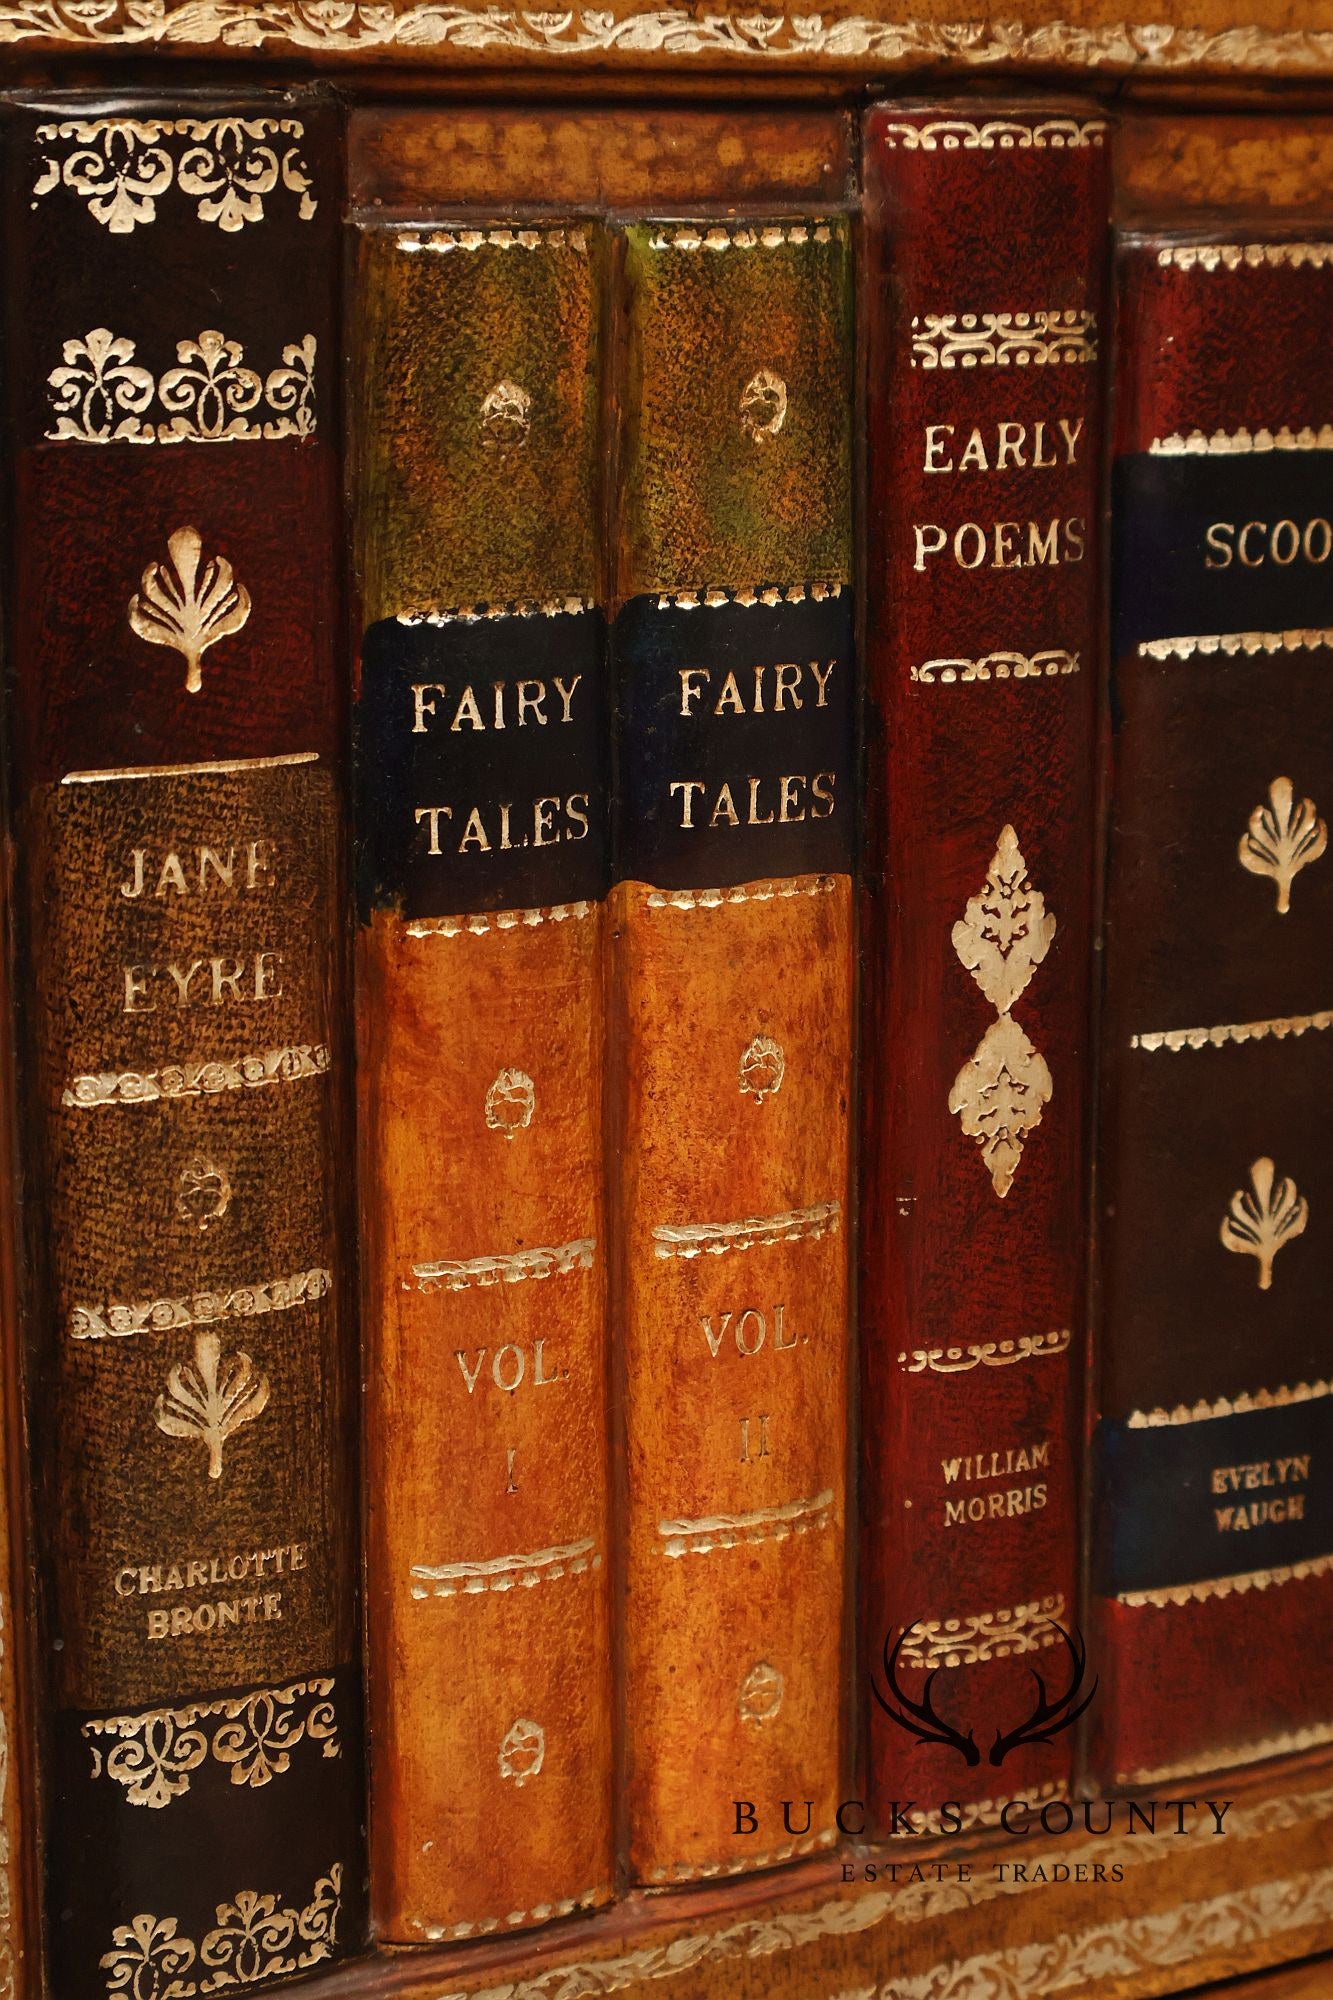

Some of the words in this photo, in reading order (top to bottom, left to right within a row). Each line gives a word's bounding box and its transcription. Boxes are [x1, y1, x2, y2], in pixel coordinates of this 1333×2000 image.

[922, 417, 1084, 474] EARLY
[912, 516, 1086, 572] POEMS
[410, 673, 582, 733] FAIRY
[678, 659, 838, 717] FAIRY
[414, 793, 590, 856] TALES
[669, 771, 837, 829] TALES
[121, 839, 278, 898] JANE
[122, 952, 283, 1013] EYRE
[700, 1303, 809, 1359] VOL.
[454, 1338, 571, 1394] VOL.
[738, 1414, 772, 1464] II
[940, 1441, 1051, 1485] WILLIAM
[1210, 1454, 1312, 1495] EVELYN
[943, 1483, 1049, 1527] MORRIS
[1213, 1494, 1306, 1533] WAUGH
[114, 1541, 308, 1597] CHARLOTTE
[147, 1592, 283, 1640] BRONTE
